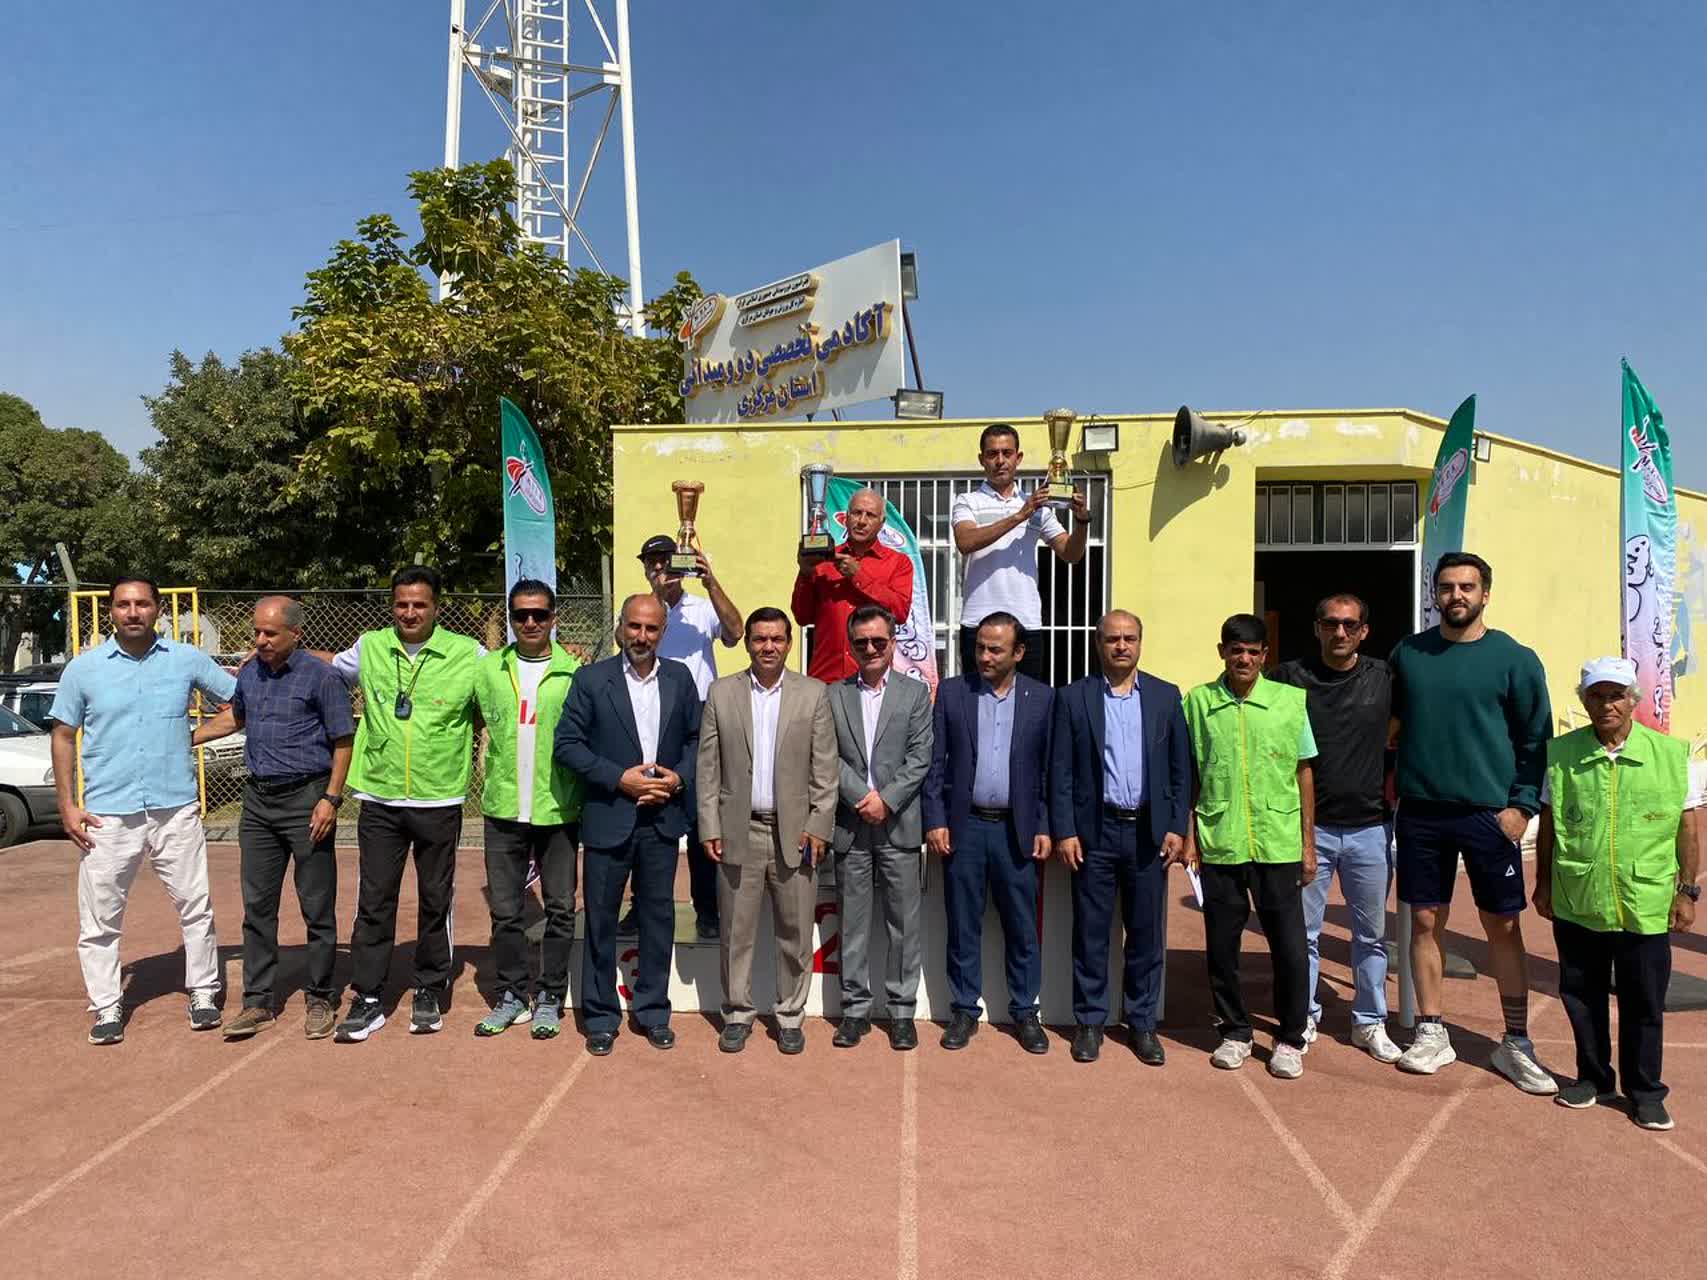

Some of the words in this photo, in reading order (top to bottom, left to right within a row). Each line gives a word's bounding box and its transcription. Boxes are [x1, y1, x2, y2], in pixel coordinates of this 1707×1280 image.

[756, 322, 813, 377] تخصصی
[815, 301, 885, 360] آکادمی
[737, 383, 777, 416] مرکزی
[777, 371, 817, 409] استان
